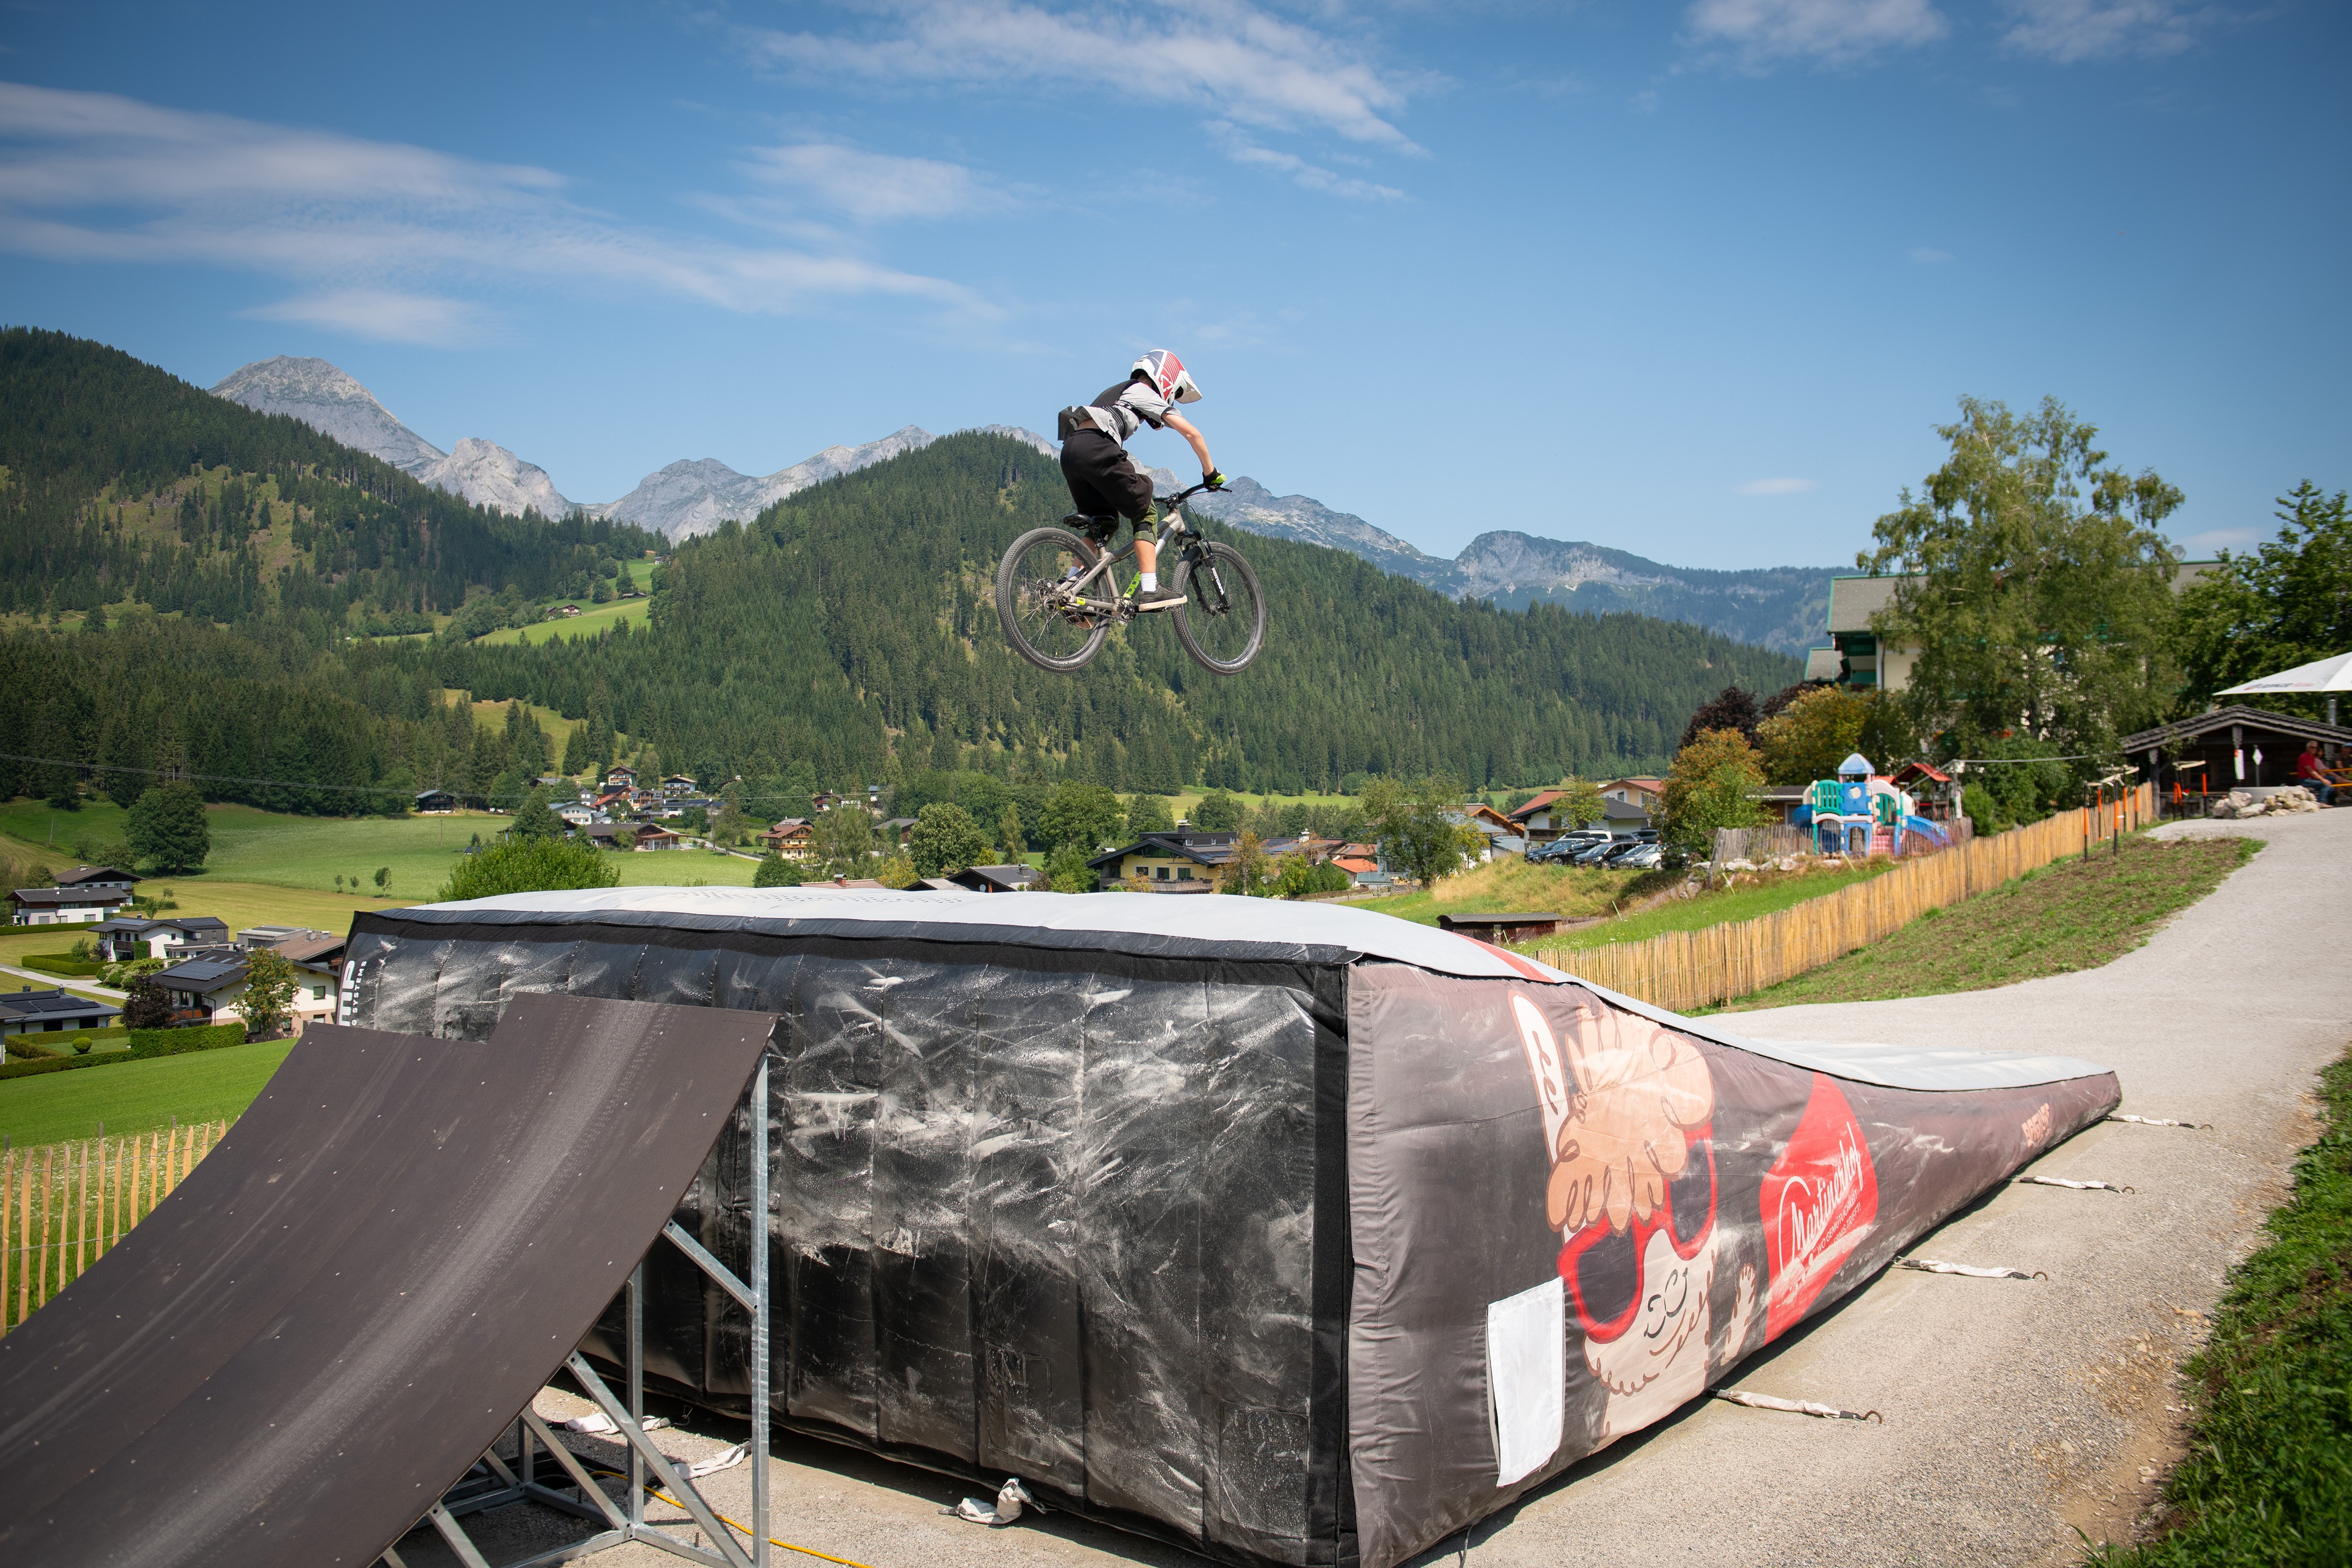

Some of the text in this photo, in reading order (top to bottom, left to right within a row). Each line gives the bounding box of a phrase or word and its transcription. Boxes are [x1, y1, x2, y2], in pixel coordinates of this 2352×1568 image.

[1052, 536, 1076, 546] KENDA
[1230, 657, 1248, 667] KENDA
[352, 961, 368, 1014] SYSTEMS
[1778, 1121, 1864, 1282] Martinerhof
[1816, 1189, 1858, 1255] WO GEMÜTLICHKEIT
